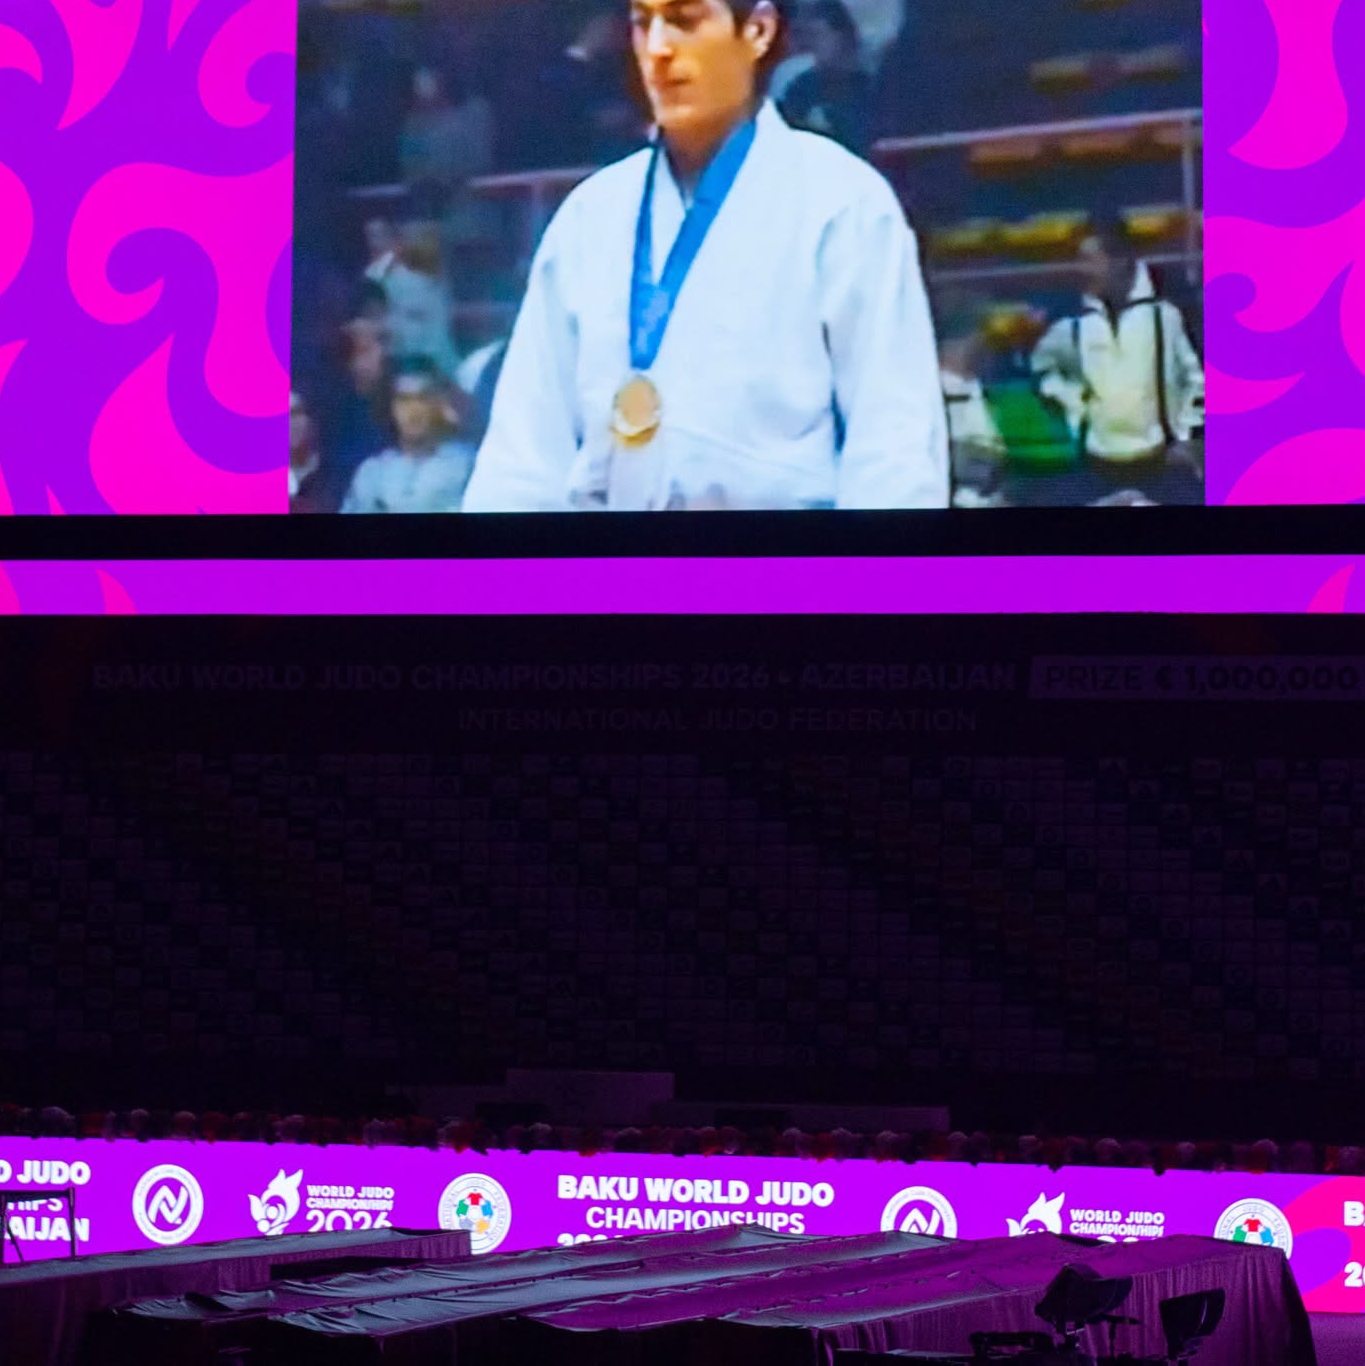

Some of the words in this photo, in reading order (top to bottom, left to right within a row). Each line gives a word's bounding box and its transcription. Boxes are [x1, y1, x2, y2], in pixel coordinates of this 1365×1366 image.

[16, 1159, 92, 1185] JUDO
[306, 1184, 355, 1198] WORLD
[357, 1186, 395, 1199] JUDO
[557, 1174, 639, 1201] BAKU
[644, 1177, 750, 1204] WORLD
[755, 1180, 835, 1207] JUDO
[306, 1209, 393, 1233] 2026
[586, 1207, 805, 1235] CHAMPIONSHIPS
[1069, 1208, 1122, 1223] WORLD
[1125, 1211, 1165, 1225] JUDO
